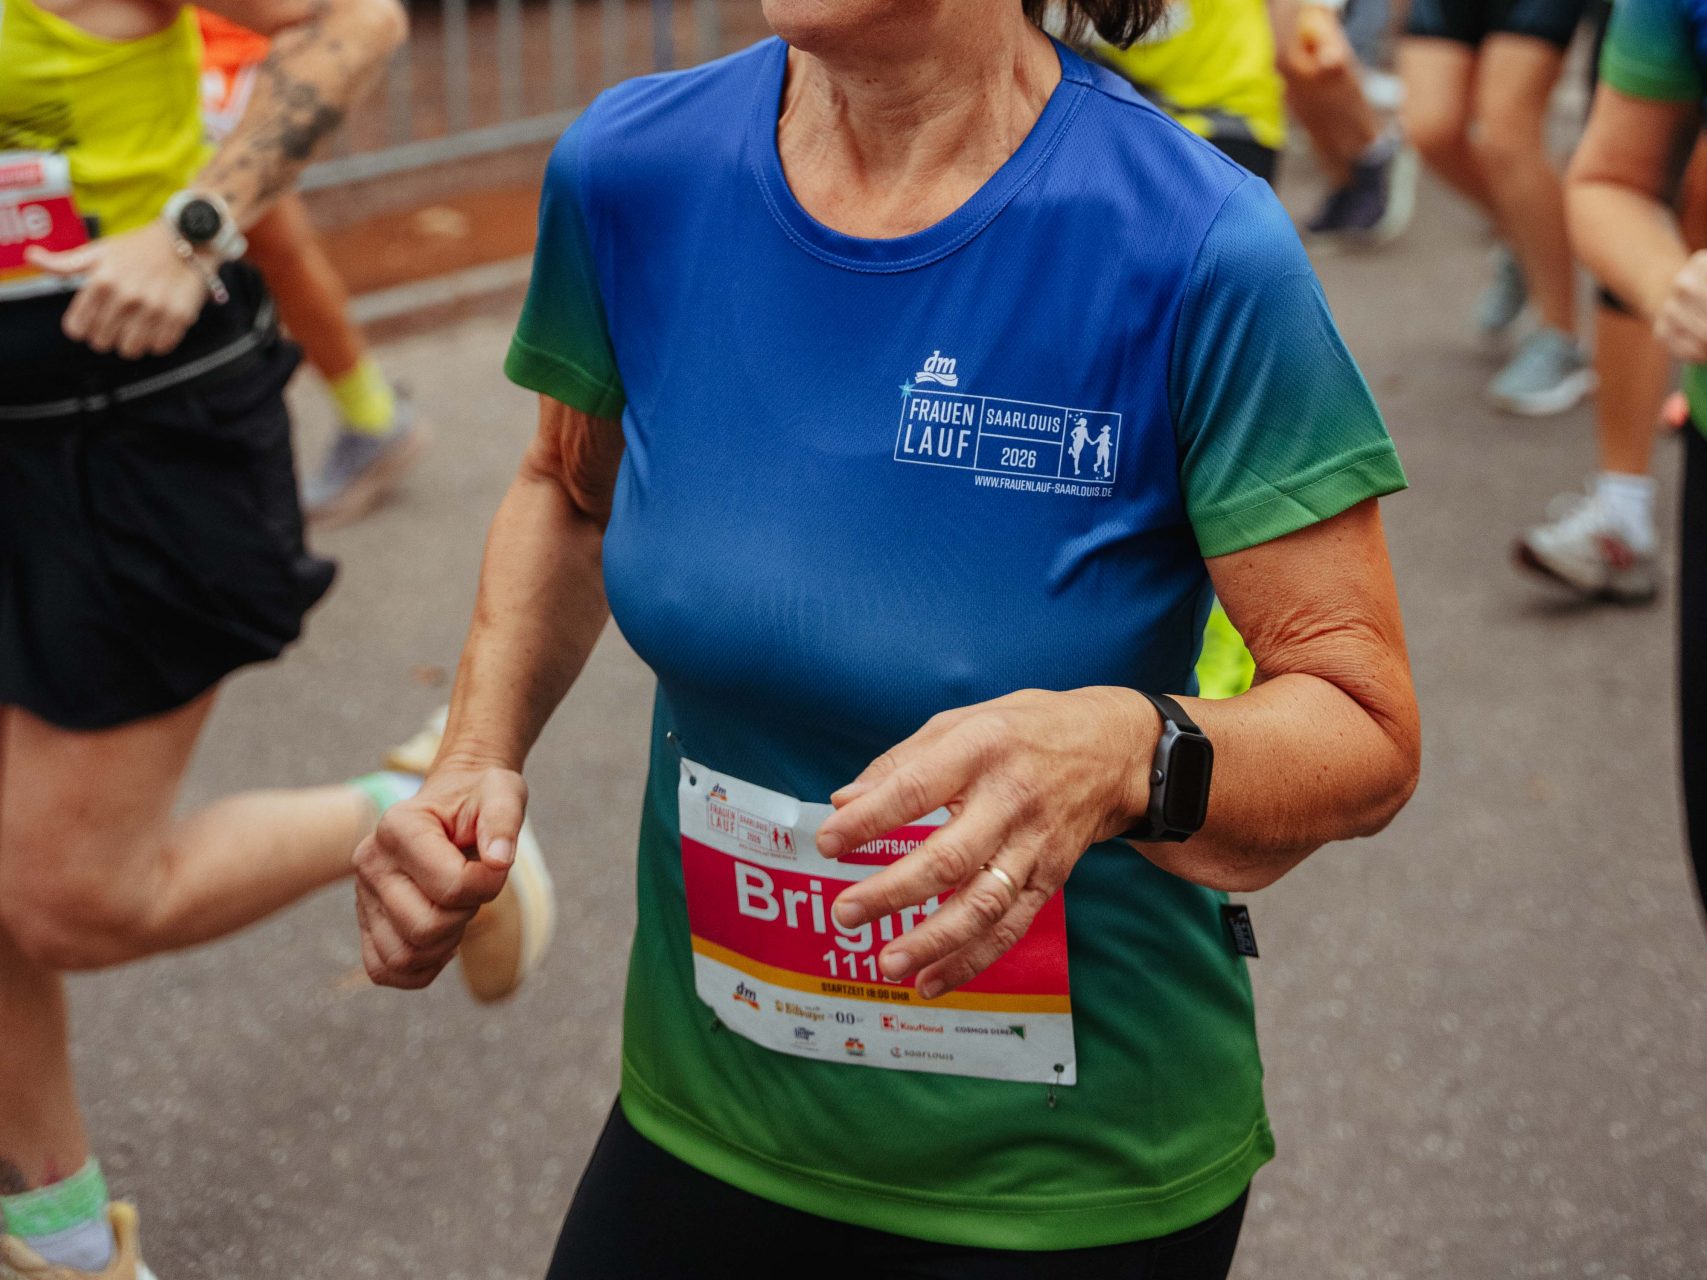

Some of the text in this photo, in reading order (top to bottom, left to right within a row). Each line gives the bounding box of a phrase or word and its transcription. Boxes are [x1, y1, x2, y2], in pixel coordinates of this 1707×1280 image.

[924, 350, 957, 374] dm
[909, 398, 975, 426] FRAUEN
[986, 408, 1061, 433] SAARLOUIS
[903, 424, 971, 459] LAUF
[1000, 447, 1037, 469] 2026
[974, 474, 1113, 498] WWW.FRAUENLAUF-SAARLOUIS.DE
[823, 950, 902, 984] 111
[736, 981, 757, 1001] dm
[821, 982, 864, 997] STARTZEIT
